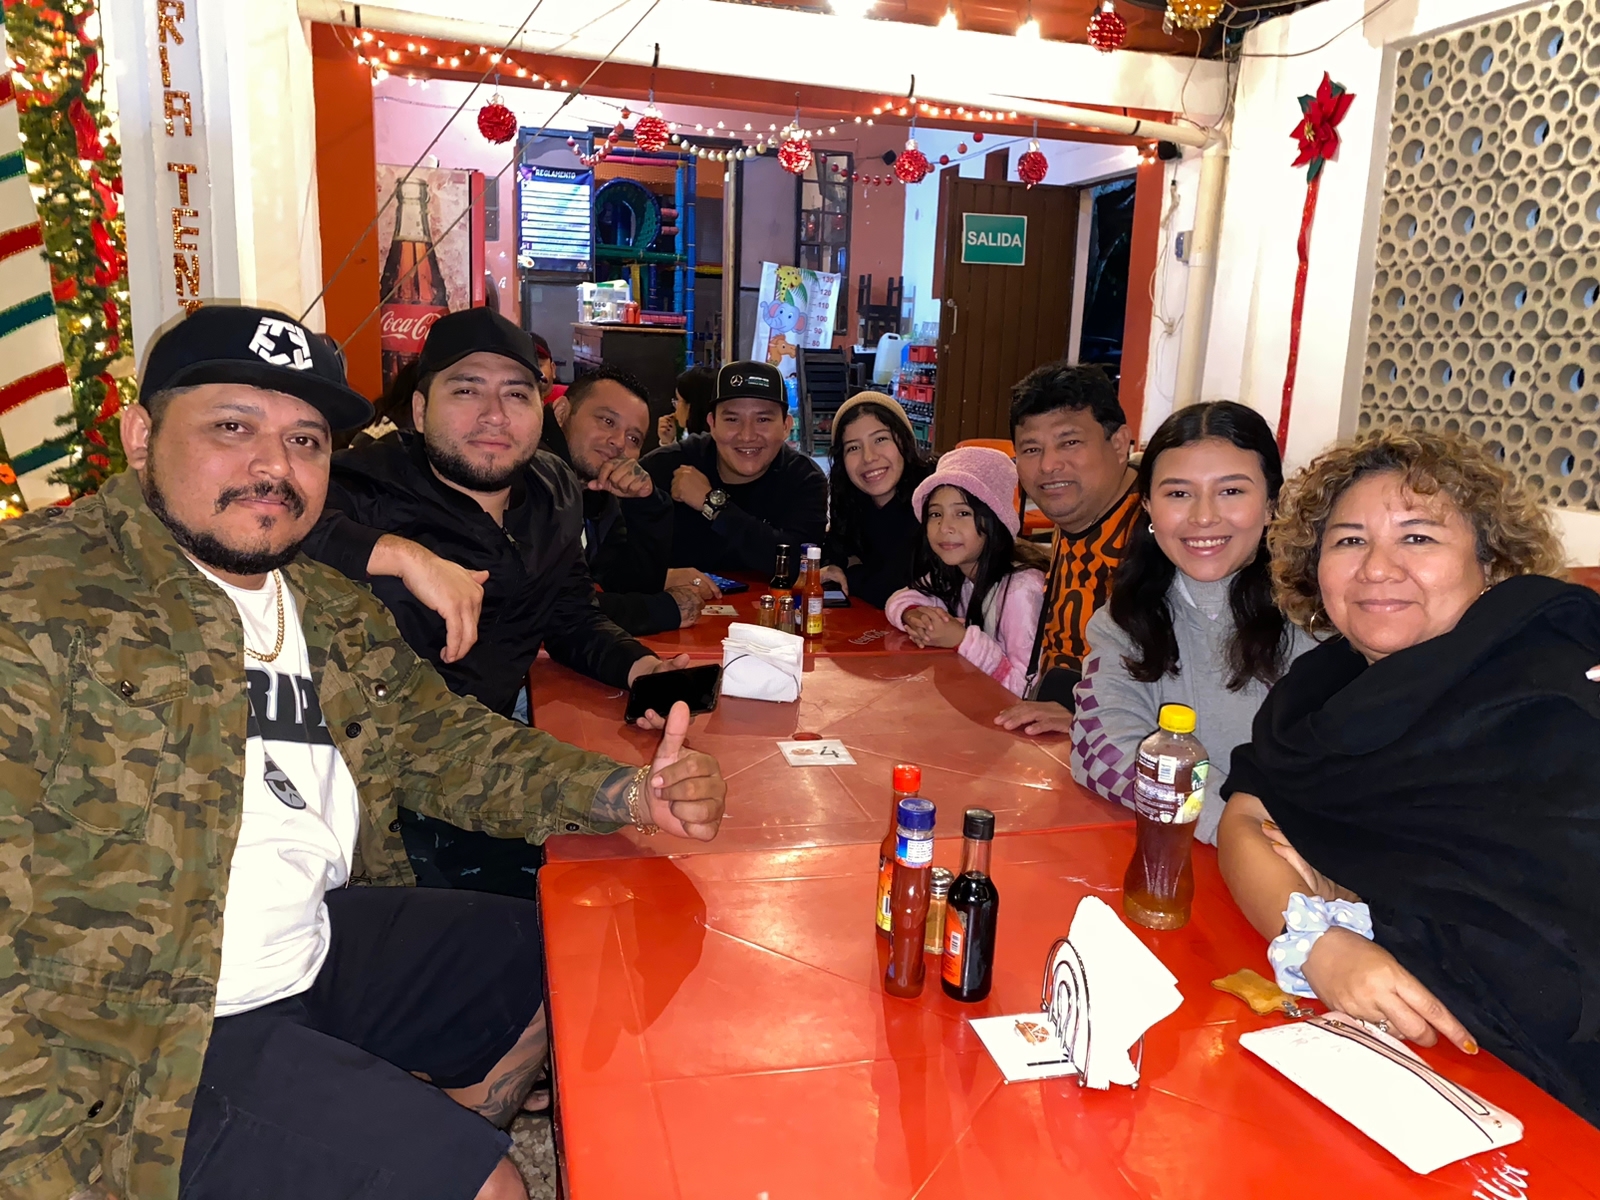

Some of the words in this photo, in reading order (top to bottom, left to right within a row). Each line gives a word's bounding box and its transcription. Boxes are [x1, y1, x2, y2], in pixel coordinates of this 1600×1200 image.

[535, 169, 576, 179] REGLAMENTO
[967, 231, 1022, 247] SALIDA
[820, 746, 839, 758] 4
